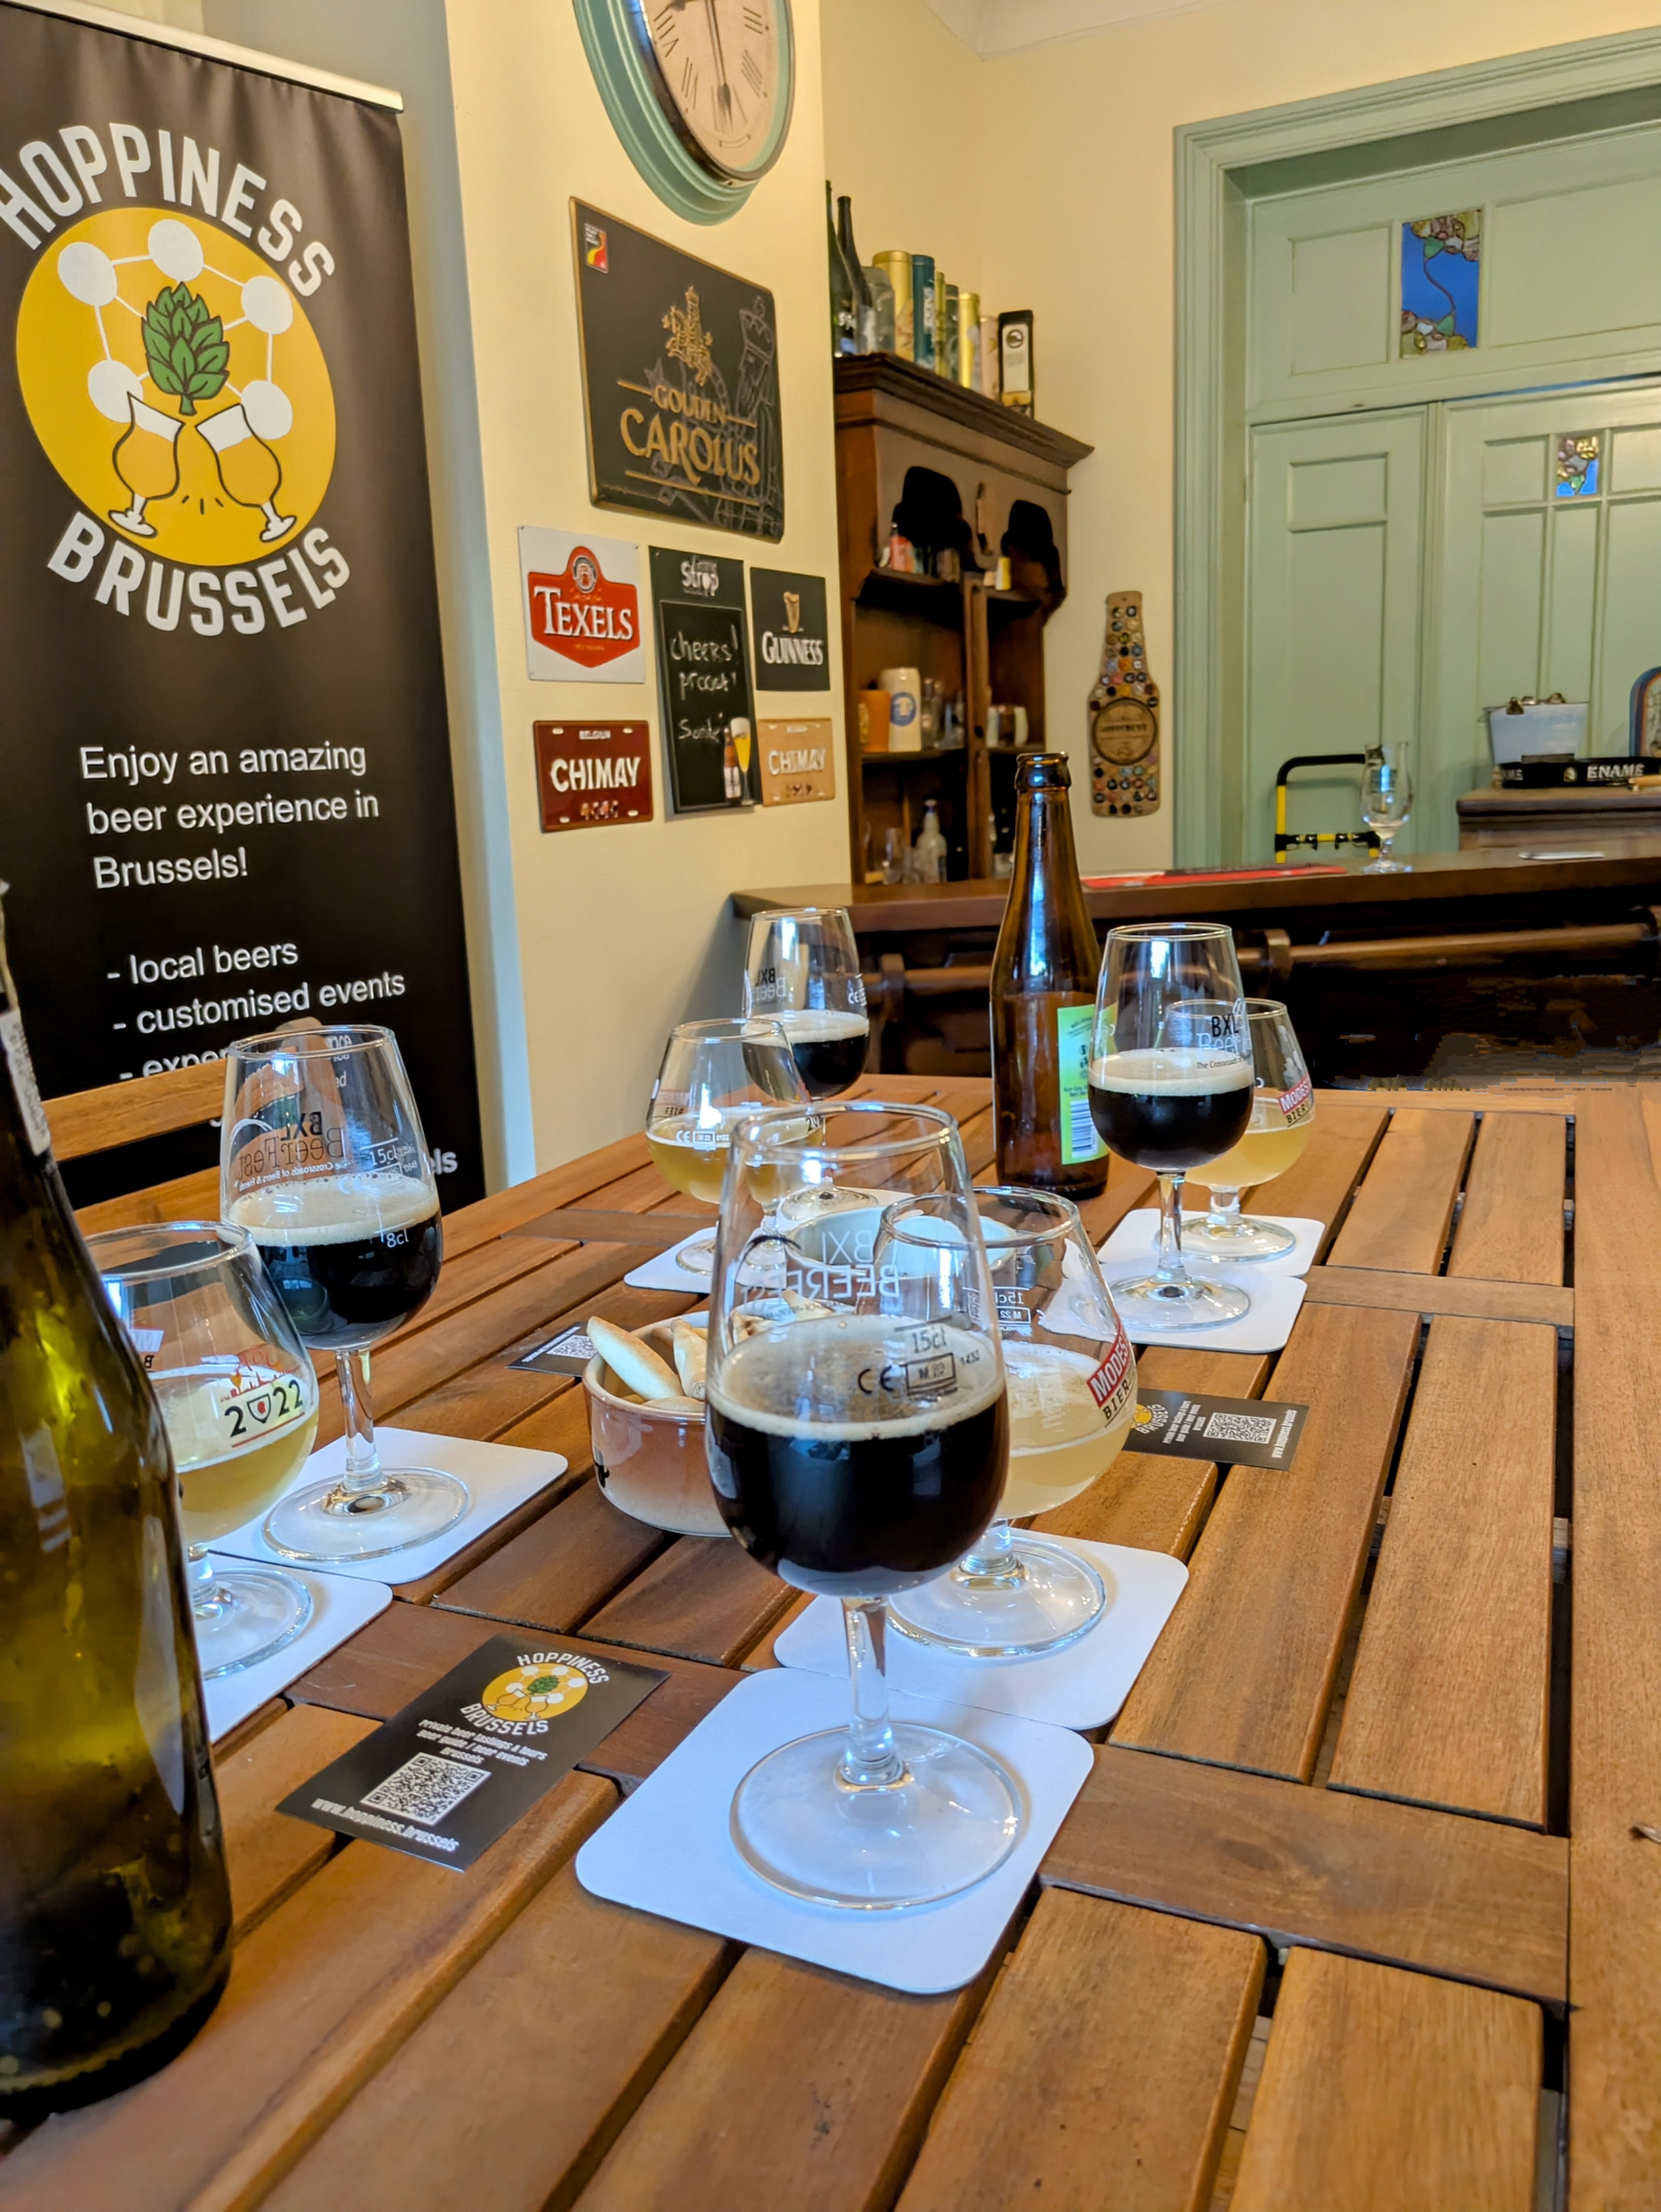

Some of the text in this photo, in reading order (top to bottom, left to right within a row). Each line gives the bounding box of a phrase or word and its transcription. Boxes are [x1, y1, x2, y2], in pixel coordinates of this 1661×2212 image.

[0, 123, 335, 298] HOPPINESS
[620, 408, 761, 486] CAROLUS
[47, 510, 351, 636] BRUSSELS
[534, 586, 633, 641] TEXELS
[763, 631, 823, 665] GUINNESS
[79, 741, 366, 786] Enjoy an amazing
[550, 757, 641, 792] CHIMAY
[769, 748, 826, 775] CHIMAY
[1586, 763, 1645, 782] ENAME
[87, 789, 379, 835] beer experience in
[93, 847, 248, 889] Brussels!
[129, 947, 205, 984] local
[213, 942, 299, 973] beers
[136, 982, 310, 1034] customised
[319, 971, 406, 1007] events
[1212, 1013, 1240, 1038] BXL
[369, 1145, 397, 1166] 15cl
[386, 1227, 410, 1249] 8cl
[1135, 1404, 1168, 1434] BRUSSELS
[517, 1652, 610, 1684] HOPPINESS
[460, 1702, 549, 1736] BRUSSELS
[438, 1736, 468, 1747] guide
[495, 1751, 530, 1767] events
[451, 1727, 476, 1739] beer
[473, 1733, 513, 1750] tastings
[518, 1746, 548, 1761] tours
[311, 1797, 460, 1853] www.hoppiness.brussels
